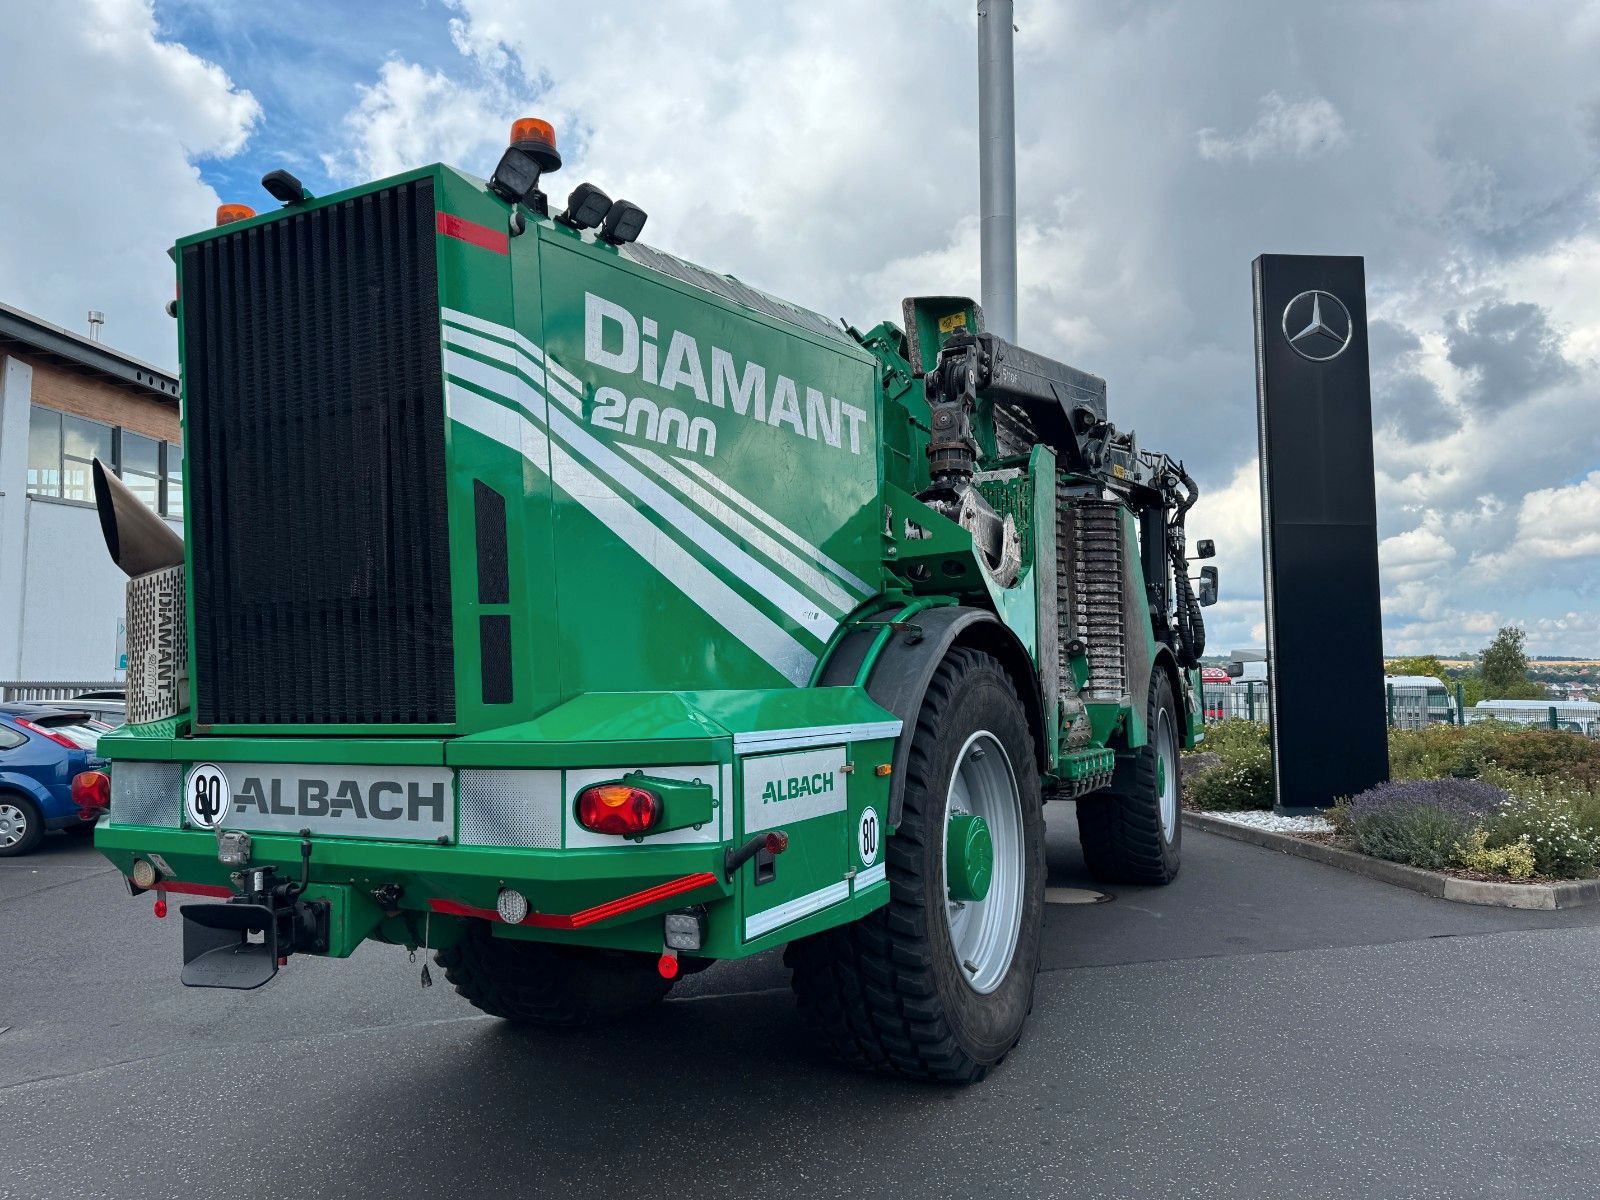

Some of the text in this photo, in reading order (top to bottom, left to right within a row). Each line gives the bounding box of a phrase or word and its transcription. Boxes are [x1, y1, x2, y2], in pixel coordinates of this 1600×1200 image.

[195, 774, 221, 817] 80
[233, 777, 445, 823] ALBACH
[761, 771, 834, 804] ALBACH
[862, 816, 876, 856] 80
